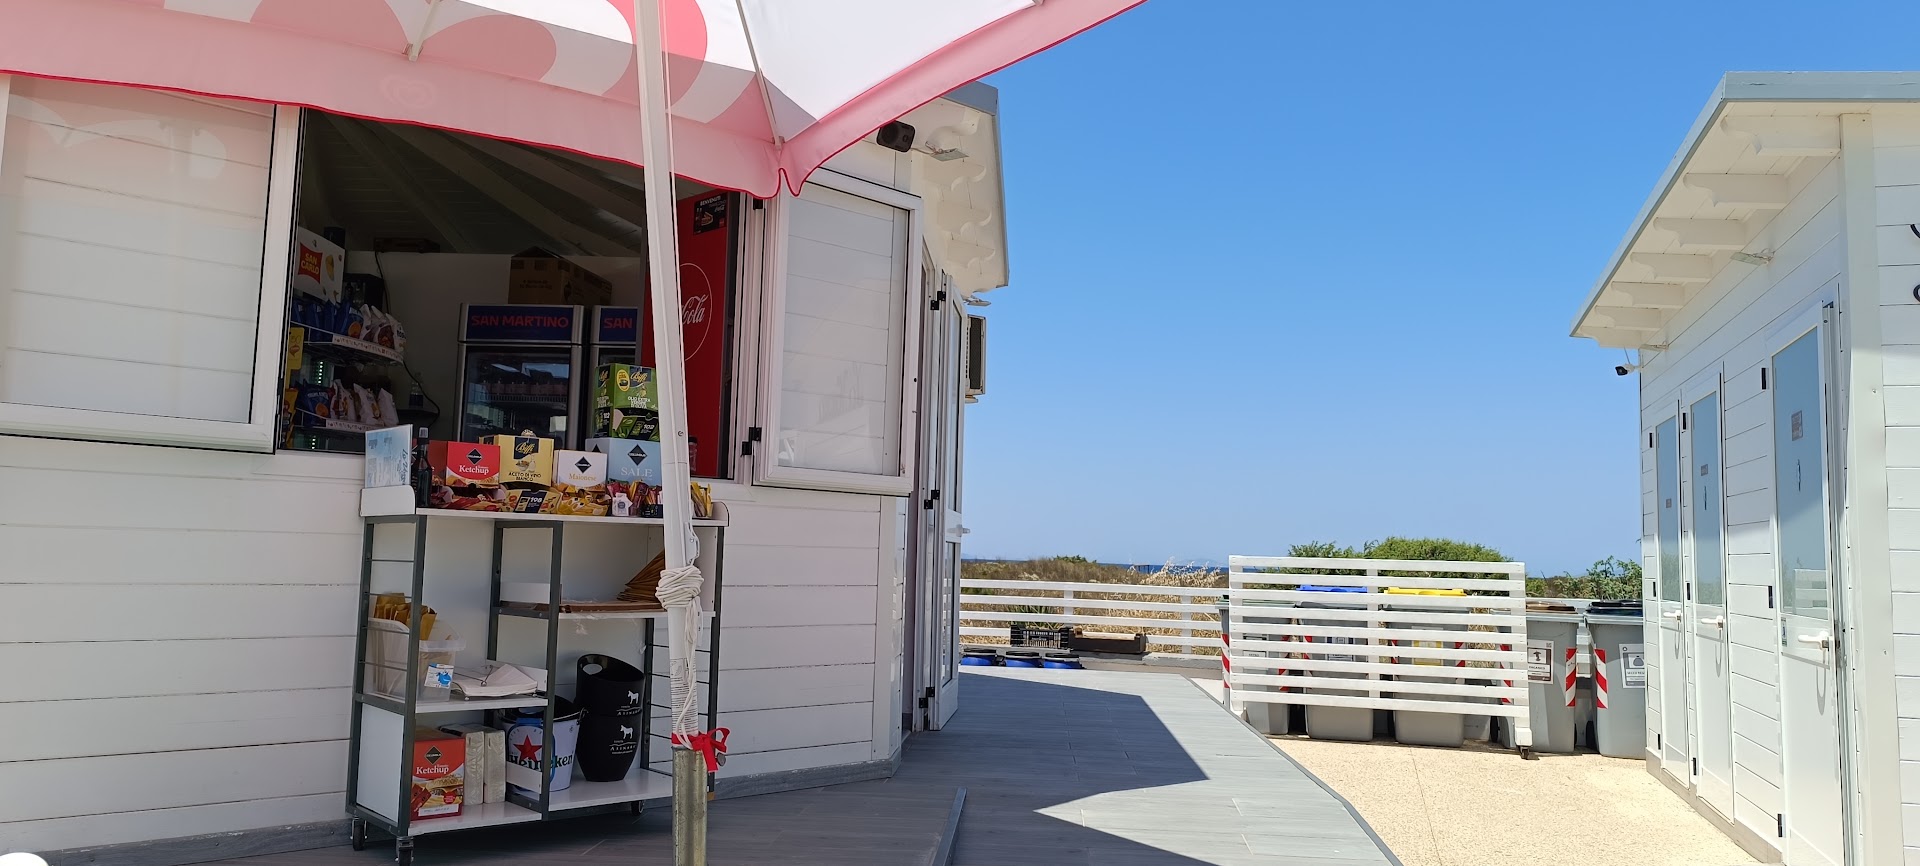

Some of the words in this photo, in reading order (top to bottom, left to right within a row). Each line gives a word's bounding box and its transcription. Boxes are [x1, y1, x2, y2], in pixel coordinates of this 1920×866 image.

[304, 252, 318, 263] SAN
[300, 260, 320, 275] CARLO
[471, 315, 499, 327] SAN
[502, 316, 569, 328] MARTINO
[603, 317, 632, 329] SAN
[459, 465, 489, 475] Ketchup
[620, 467, 653, 477] SALE
[569, 473, 597, 482] Maionese
[416, 765, 449, 775] Ketchup
